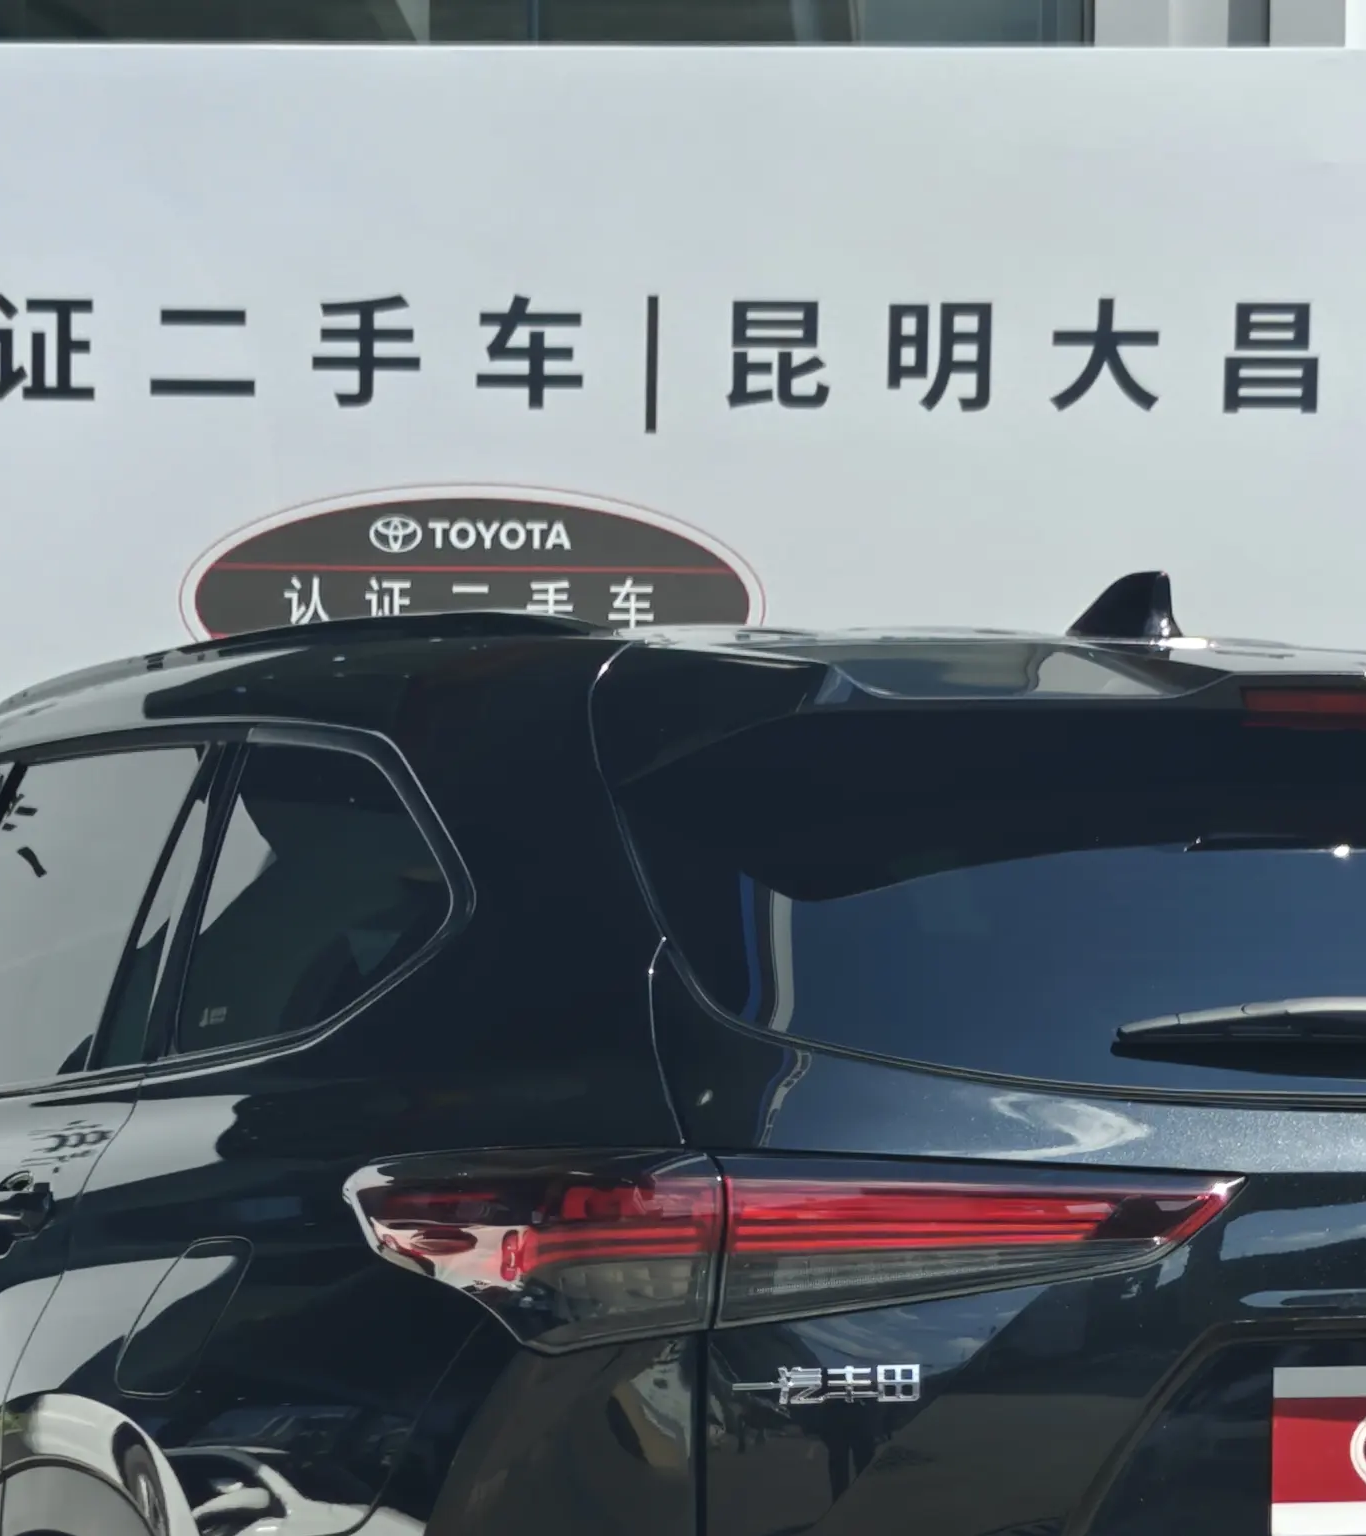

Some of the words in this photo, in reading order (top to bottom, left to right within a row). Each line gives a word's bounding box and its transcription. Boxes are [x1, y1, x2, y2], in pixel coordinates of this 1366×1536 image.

[428, 520, 571, 550] TOYOTA
[732, 1363, 921, 1405] 一汽丰田
